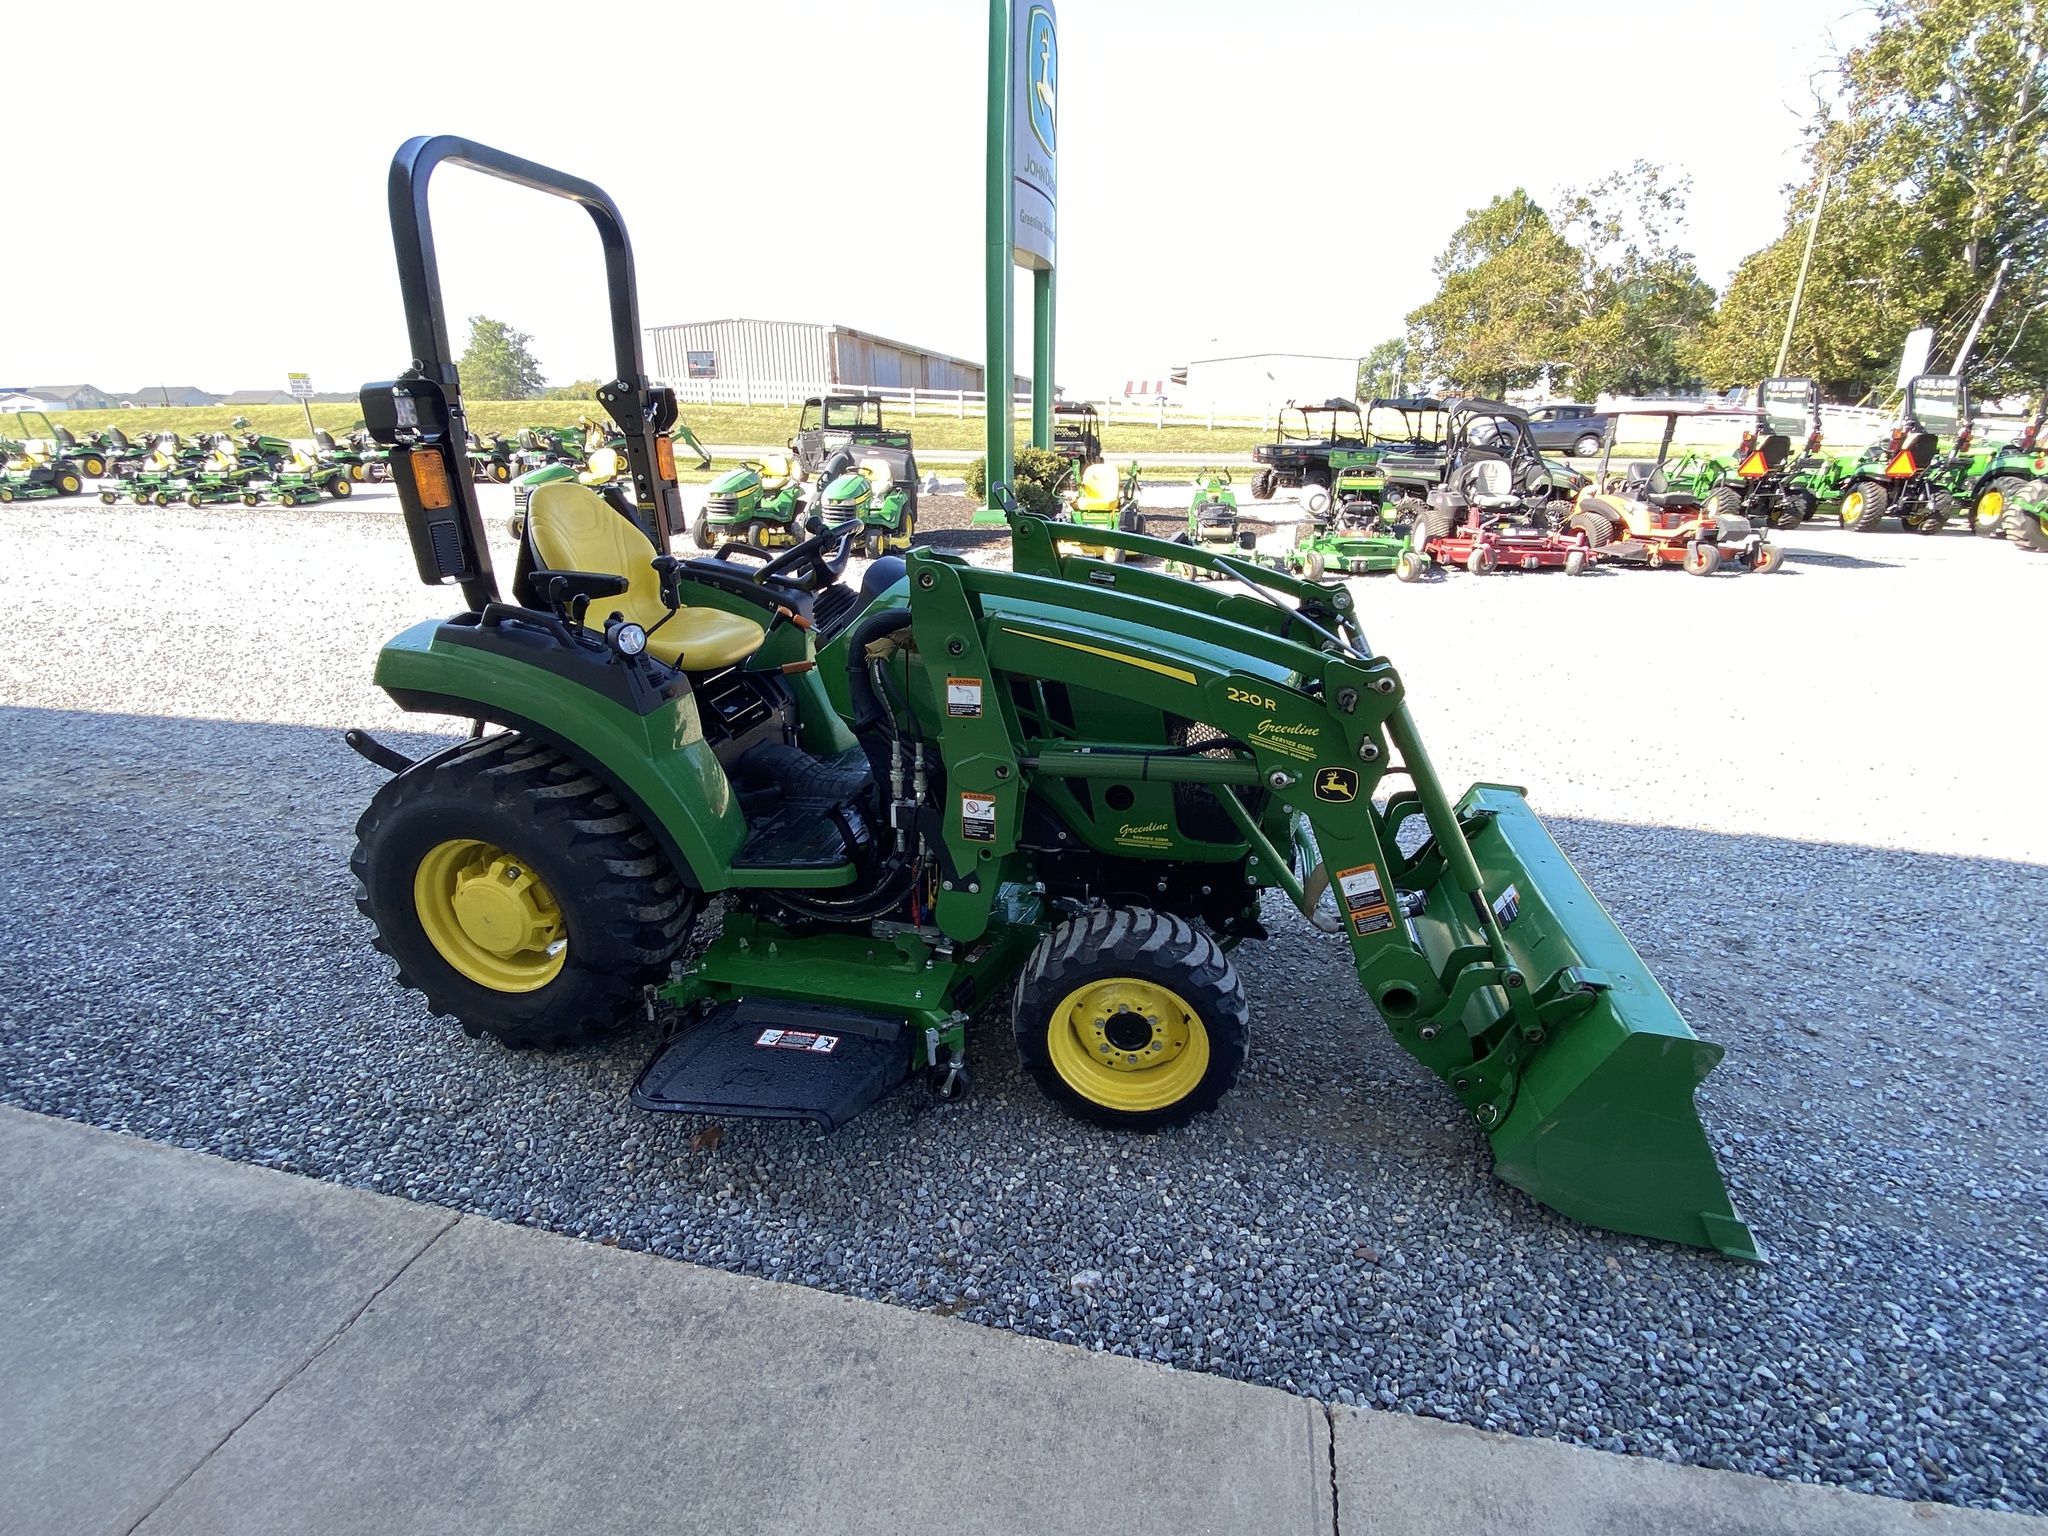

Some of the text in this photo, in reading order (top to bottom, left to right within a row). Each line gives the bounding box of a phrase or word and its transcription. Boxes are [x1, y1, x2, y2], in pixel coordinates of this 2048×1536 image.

[1024, 153, 1045, 183] JOHN
[1020, 208, 1044, 232] Greenline
[1227, 687, 1277, 711] 220 R
[1257, 719, 1320, 736] Greenline
[1271, 735, 1297, 747] SERVICE
[1119, 822, 1168, 837] Greenline
